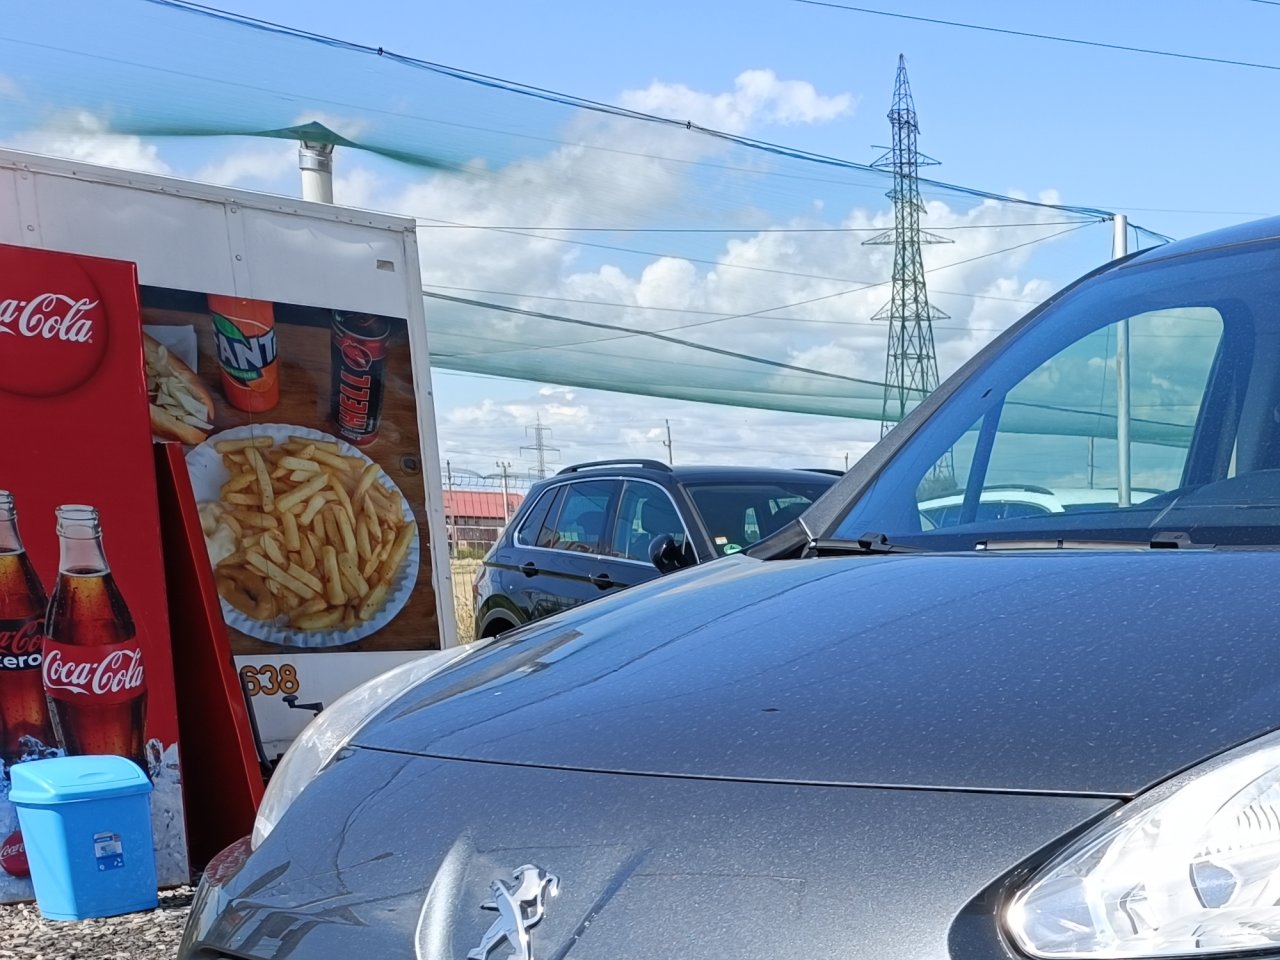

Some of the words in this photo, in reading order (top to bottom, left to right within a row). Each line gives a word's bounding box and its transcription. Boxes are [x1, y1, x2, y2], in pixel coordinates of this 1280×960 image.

[212, 325, 277, 370] ANT
[0, 653, 42, 668] ero
[43, 648, 144, 695] Coca-Cola
